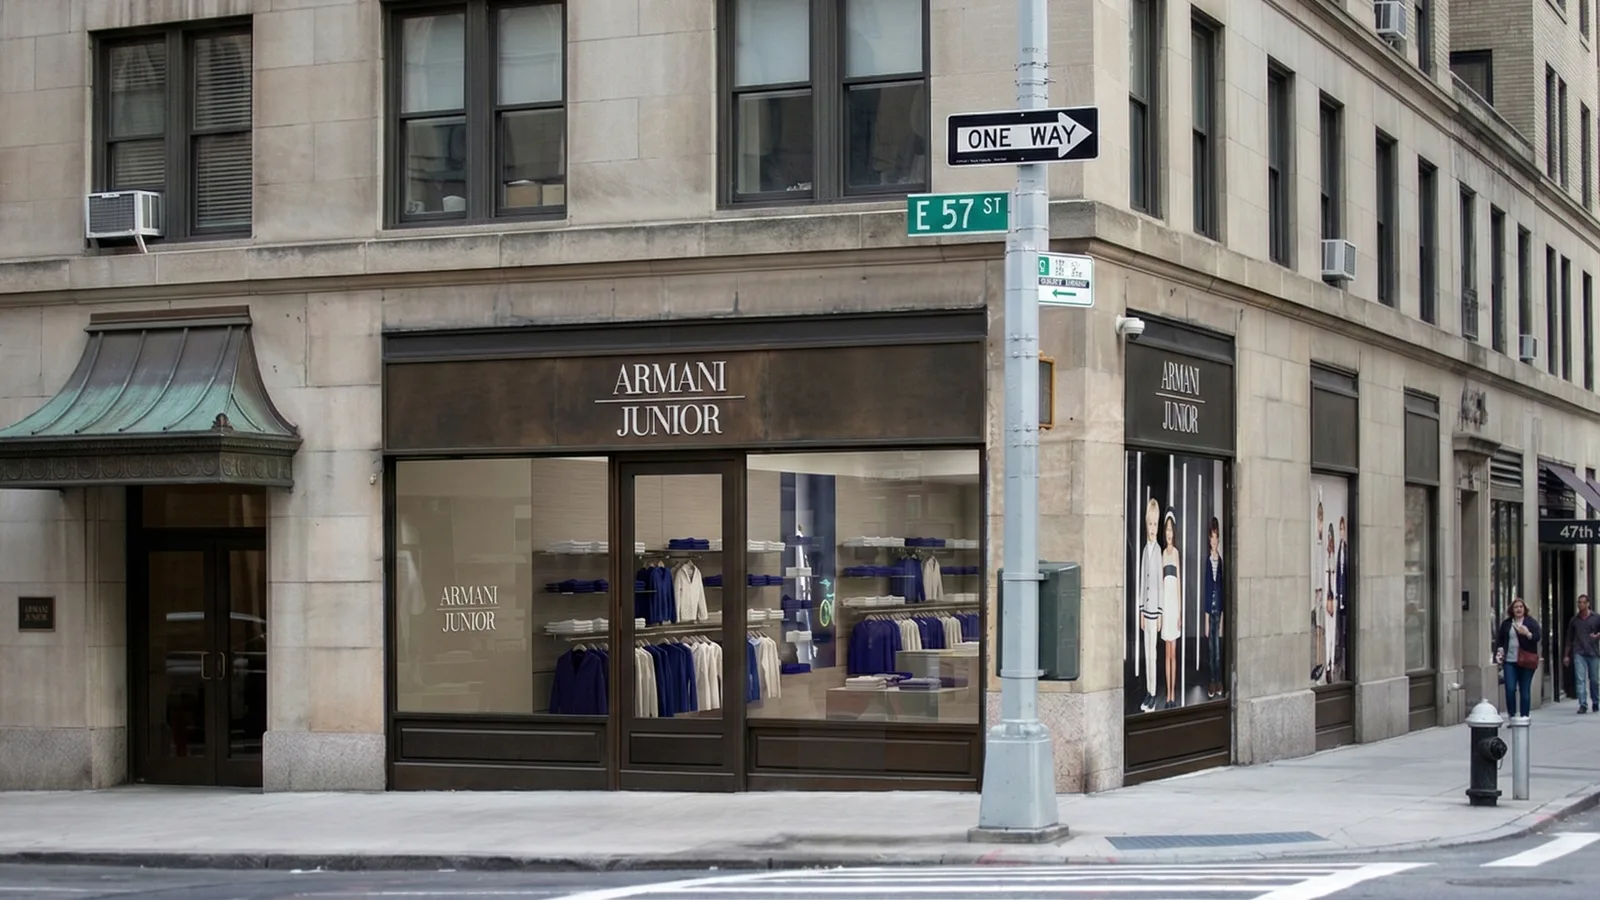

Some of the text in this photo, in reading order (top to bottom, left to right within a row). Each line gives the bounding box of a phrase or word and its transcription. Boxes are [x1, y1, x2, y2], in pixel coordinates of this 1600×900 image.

[968, 124, 1076, 149] ONE WAY
[916, 197, 1001, 231] E 57 ST
[613, 360, 727, 395] ARMANI
[1161, 360, 1200, 396] ARMANI
[616, 403, 723, 437] JUNIOR
[1162, 401, 1199, 434] JUNIOR
[1560, 525, 1593, 539] 47th
[440, 585, 498, 606] ARMANI
[442, 611, 496, 632] JUNIOR
